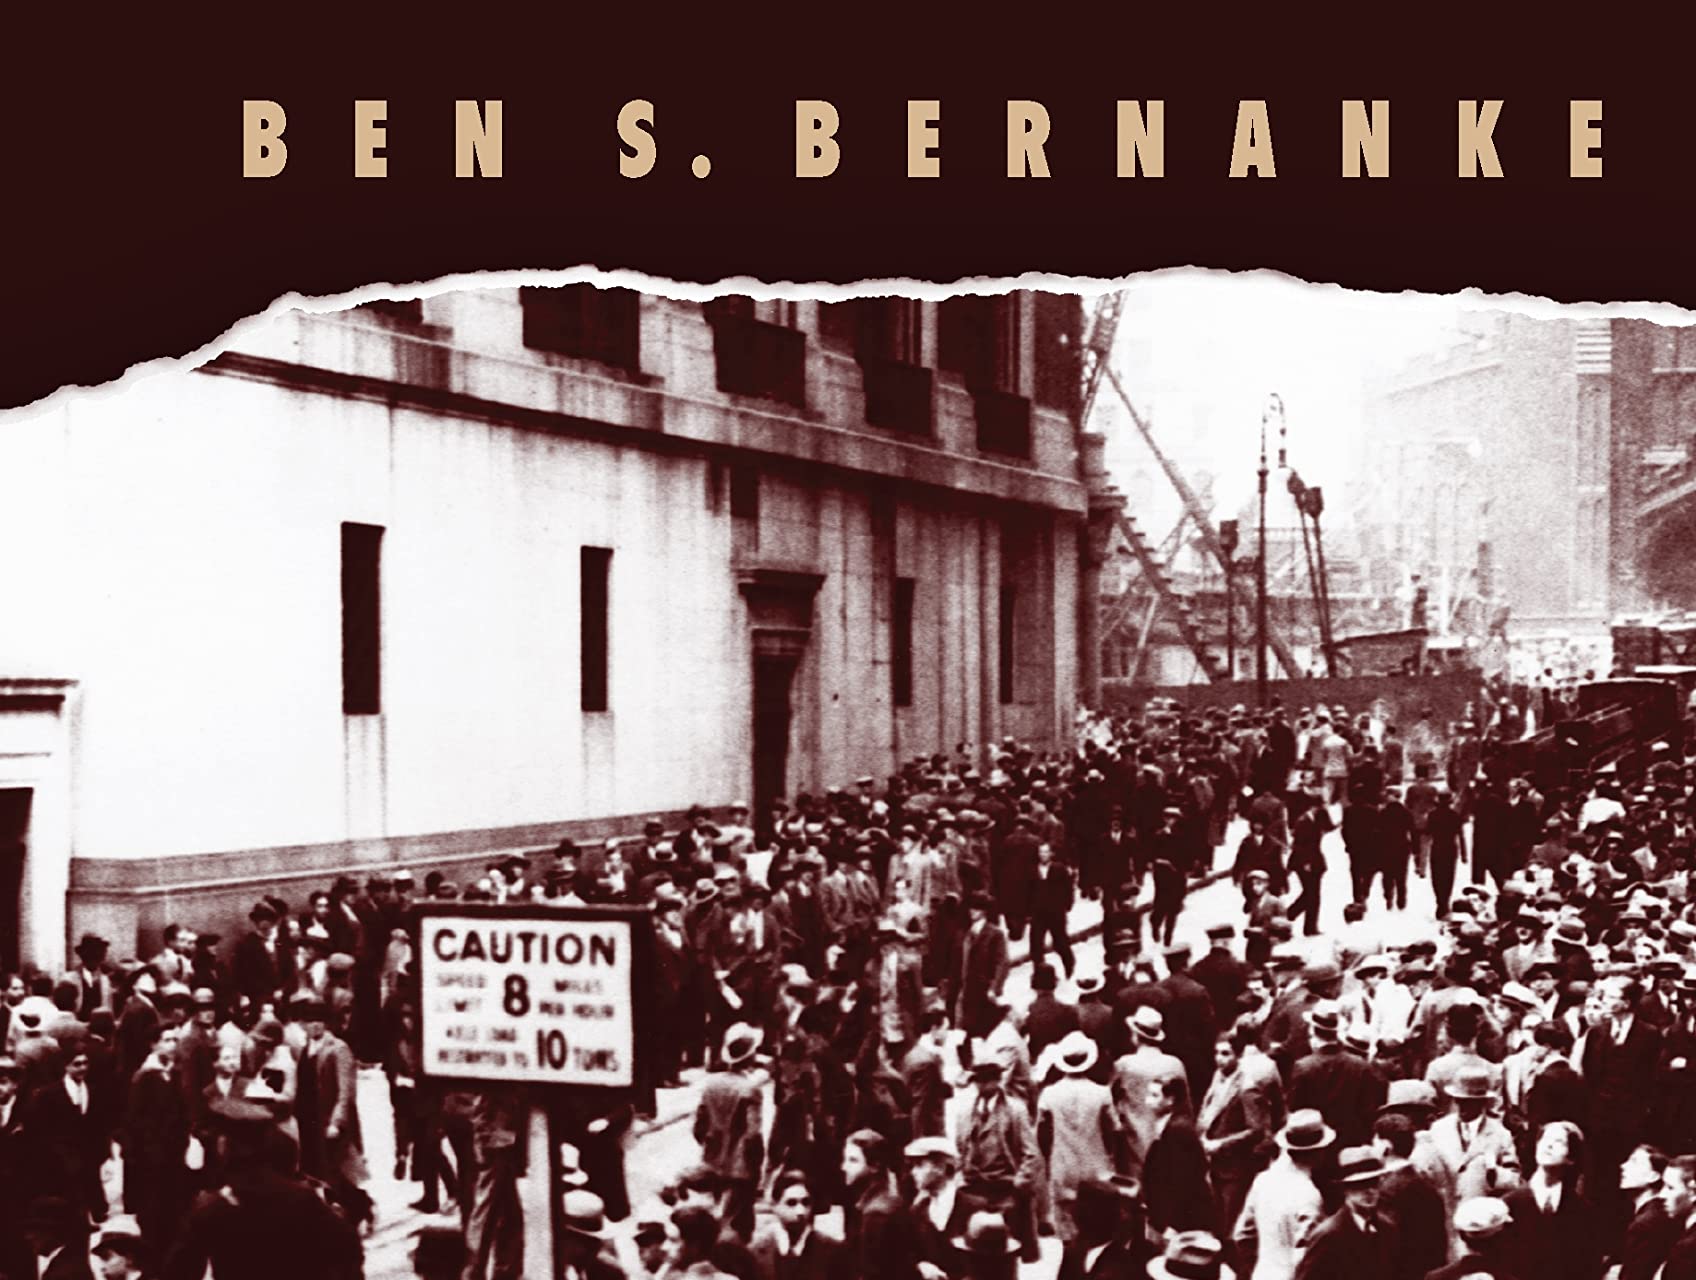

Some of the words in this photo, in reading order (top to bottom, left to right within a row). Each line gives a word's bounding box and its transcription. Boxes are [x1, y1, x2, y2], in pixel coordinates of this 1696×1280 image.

[433, 928, 616, 967] CAUTION
[503, 974, 531, 1017] 8
[536, 1028, 568, 1071] 10
